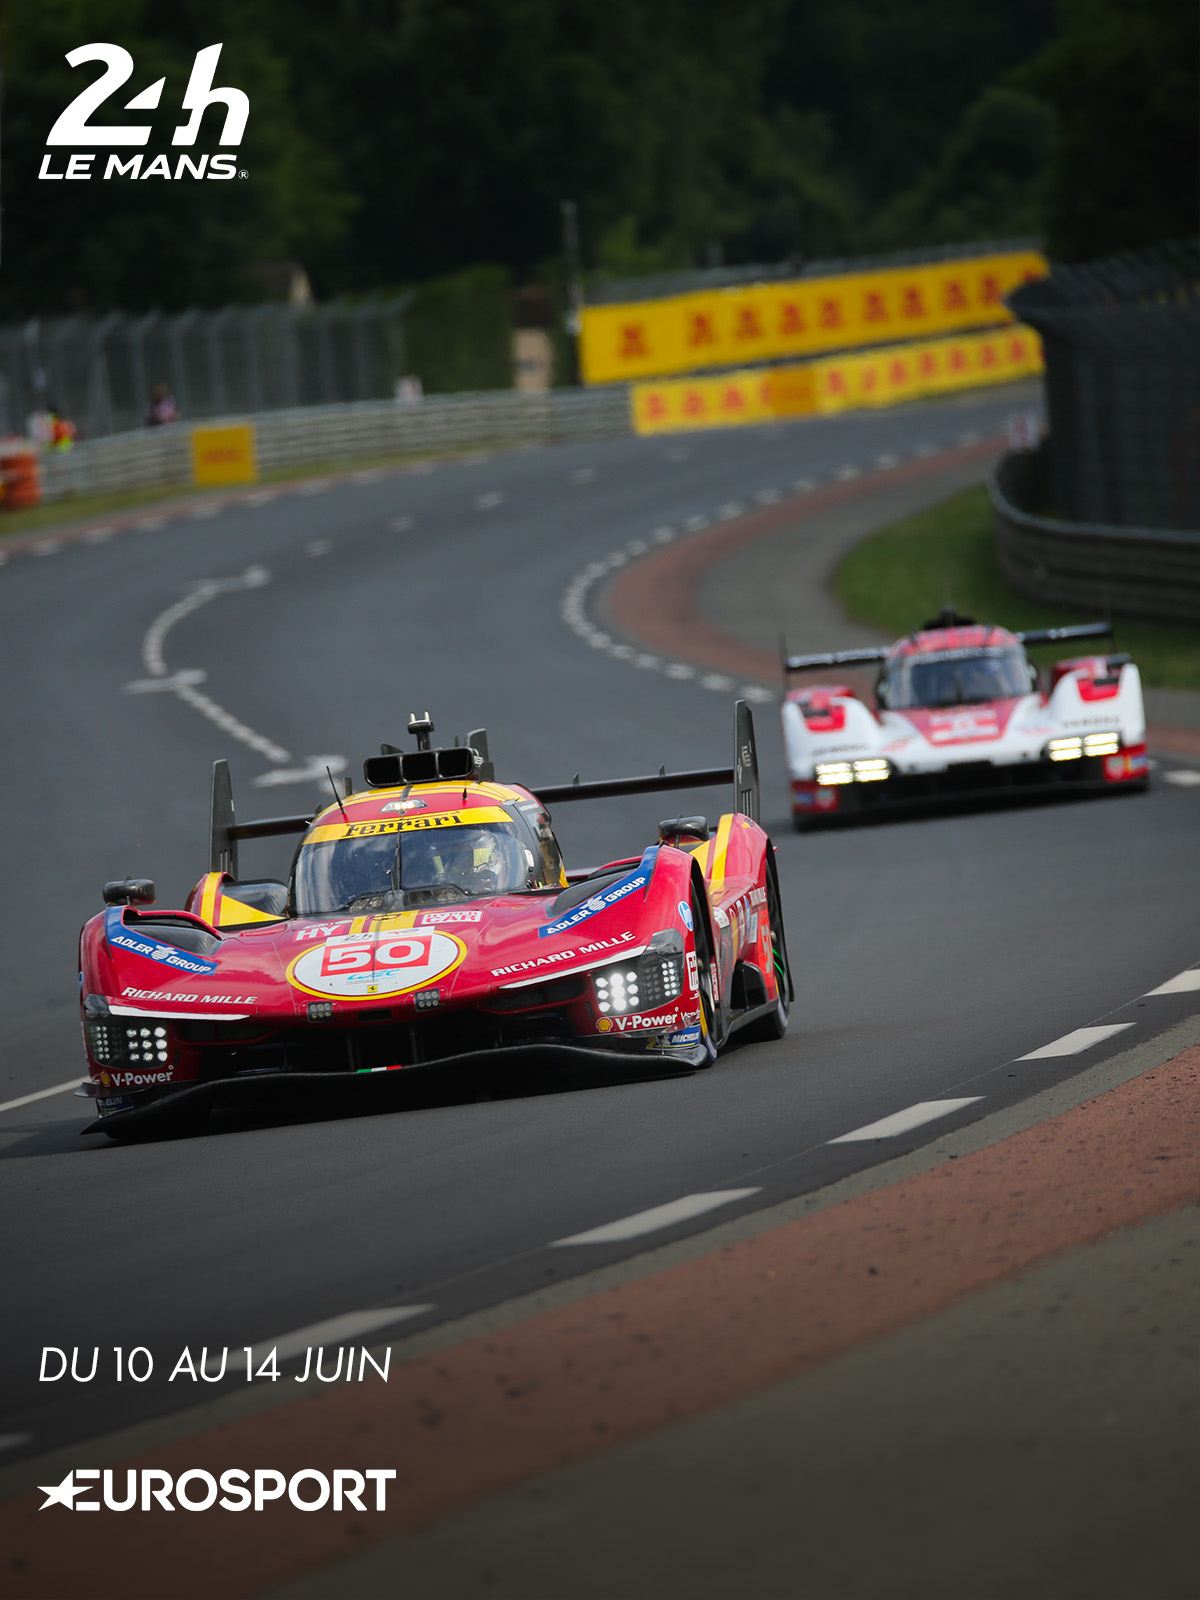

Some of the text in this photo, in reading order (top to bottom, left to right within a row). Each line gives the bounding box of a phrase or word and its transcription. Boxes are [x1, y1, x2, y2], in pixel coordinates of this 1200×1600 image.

[341, 812, 462, 838] Ferrari
[547, 877, 646, 934] ADLER GROUP
[426, 914, 477, 923] CAR
[296, 925, 342, 941] HY
[110, 936, 212, 973] ADLER GROUP
[328, 941, 425, 971] 50
[490, 931, 636, 977] RICHARD MILLE
[121, 987, 258, 1004] RICHARD MILLE
[615, 1012, 678, 1030] V-Power
[111, 1072, 173, 1086] V-Power
